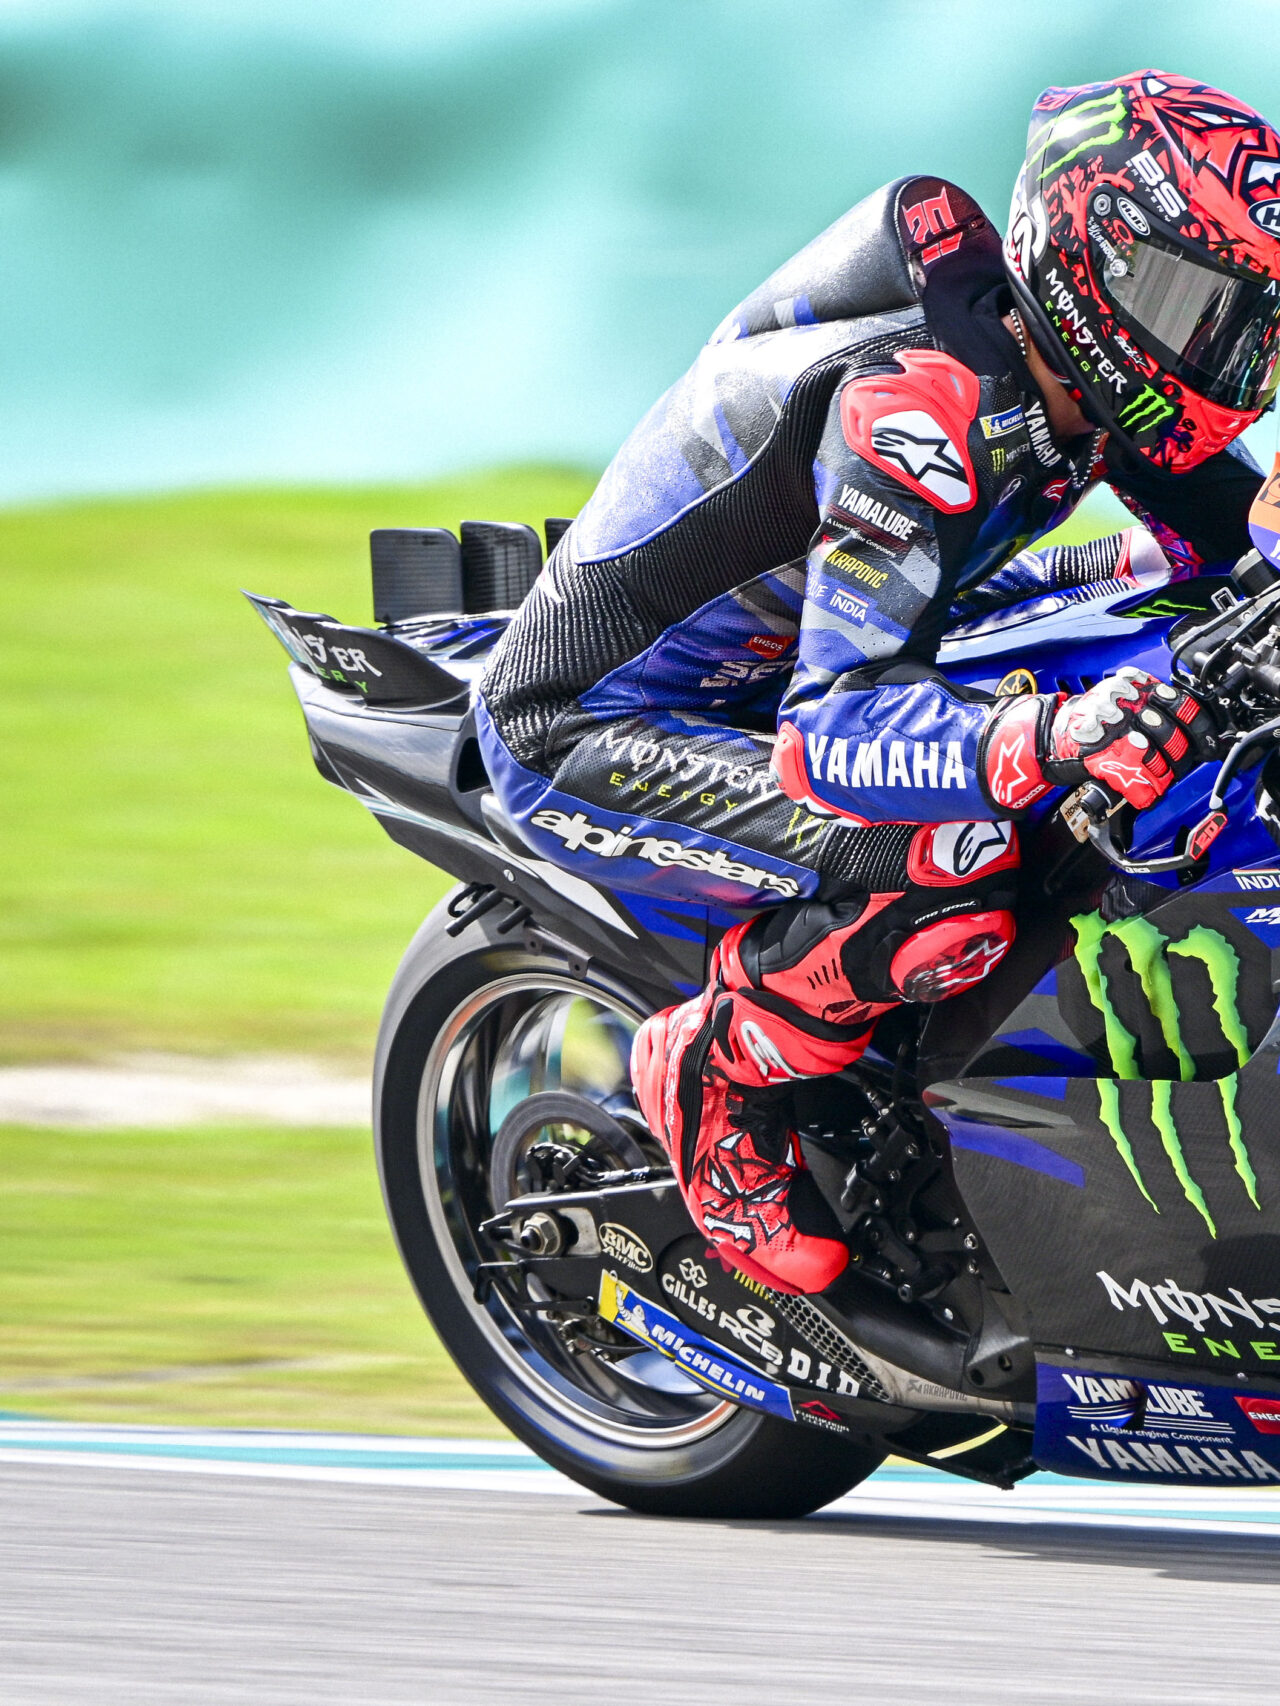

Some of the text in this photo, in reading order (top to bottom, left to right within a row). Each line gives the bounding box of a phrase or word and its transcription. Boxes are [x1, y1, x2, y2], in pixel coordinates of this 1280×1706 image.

[1130, 150, 1188, 217] BS
[1045, 300, 1100, 383] ENERGY
[1025, 401, 1062, 467] YAMAHA
[838, 484, 918, 541] YAMALUBE
[829, 594, 867, 622] INDIA
[753, 636, 784, 651] ENEOS
[807, 732, 968, 790] YAMAHA
[530, 809, 799, 897] alpinestars
[602, 1229, 651, 1268] BMC
[662, 1273, 717, 1321] GILLES
[651, 1324, 765, 1401] MICHELIN
[719, 1311, 783, 1365] RCB
[1062, 1373, 1214, 1419] YAMLUBE
[1091, 1423, 1099, 1431] A
[1171, 1431, 1232, 1445] Component
